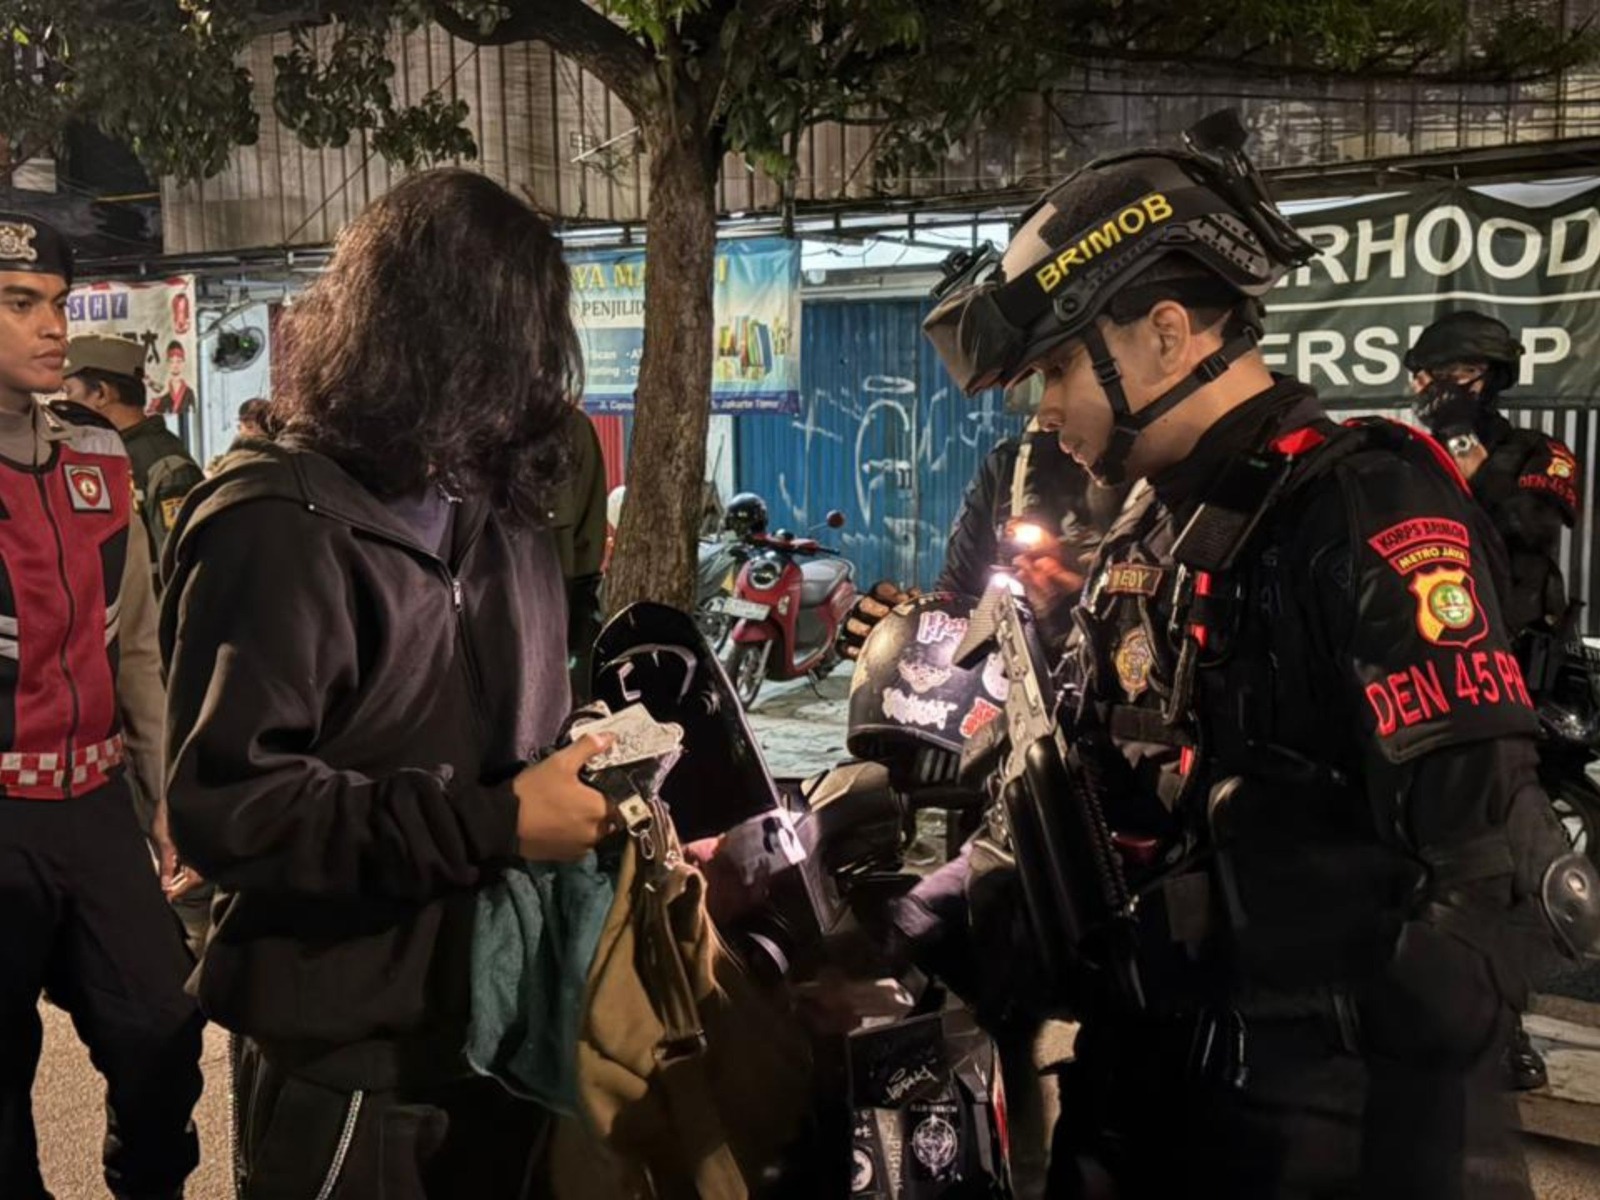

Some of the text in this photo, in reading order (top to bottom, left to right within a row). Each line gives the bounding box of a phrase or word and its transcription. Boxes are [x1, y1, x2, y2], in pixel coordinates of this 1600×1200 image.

[1035, 193, 1174, 294] BRIMOB
[1273, 204, 1600, 288] RHOOD
[1398, 547, 1441, 569] METRO
[1365, 660, 1450, 736] DEN
[1455, 652, 1500, 706] 45
